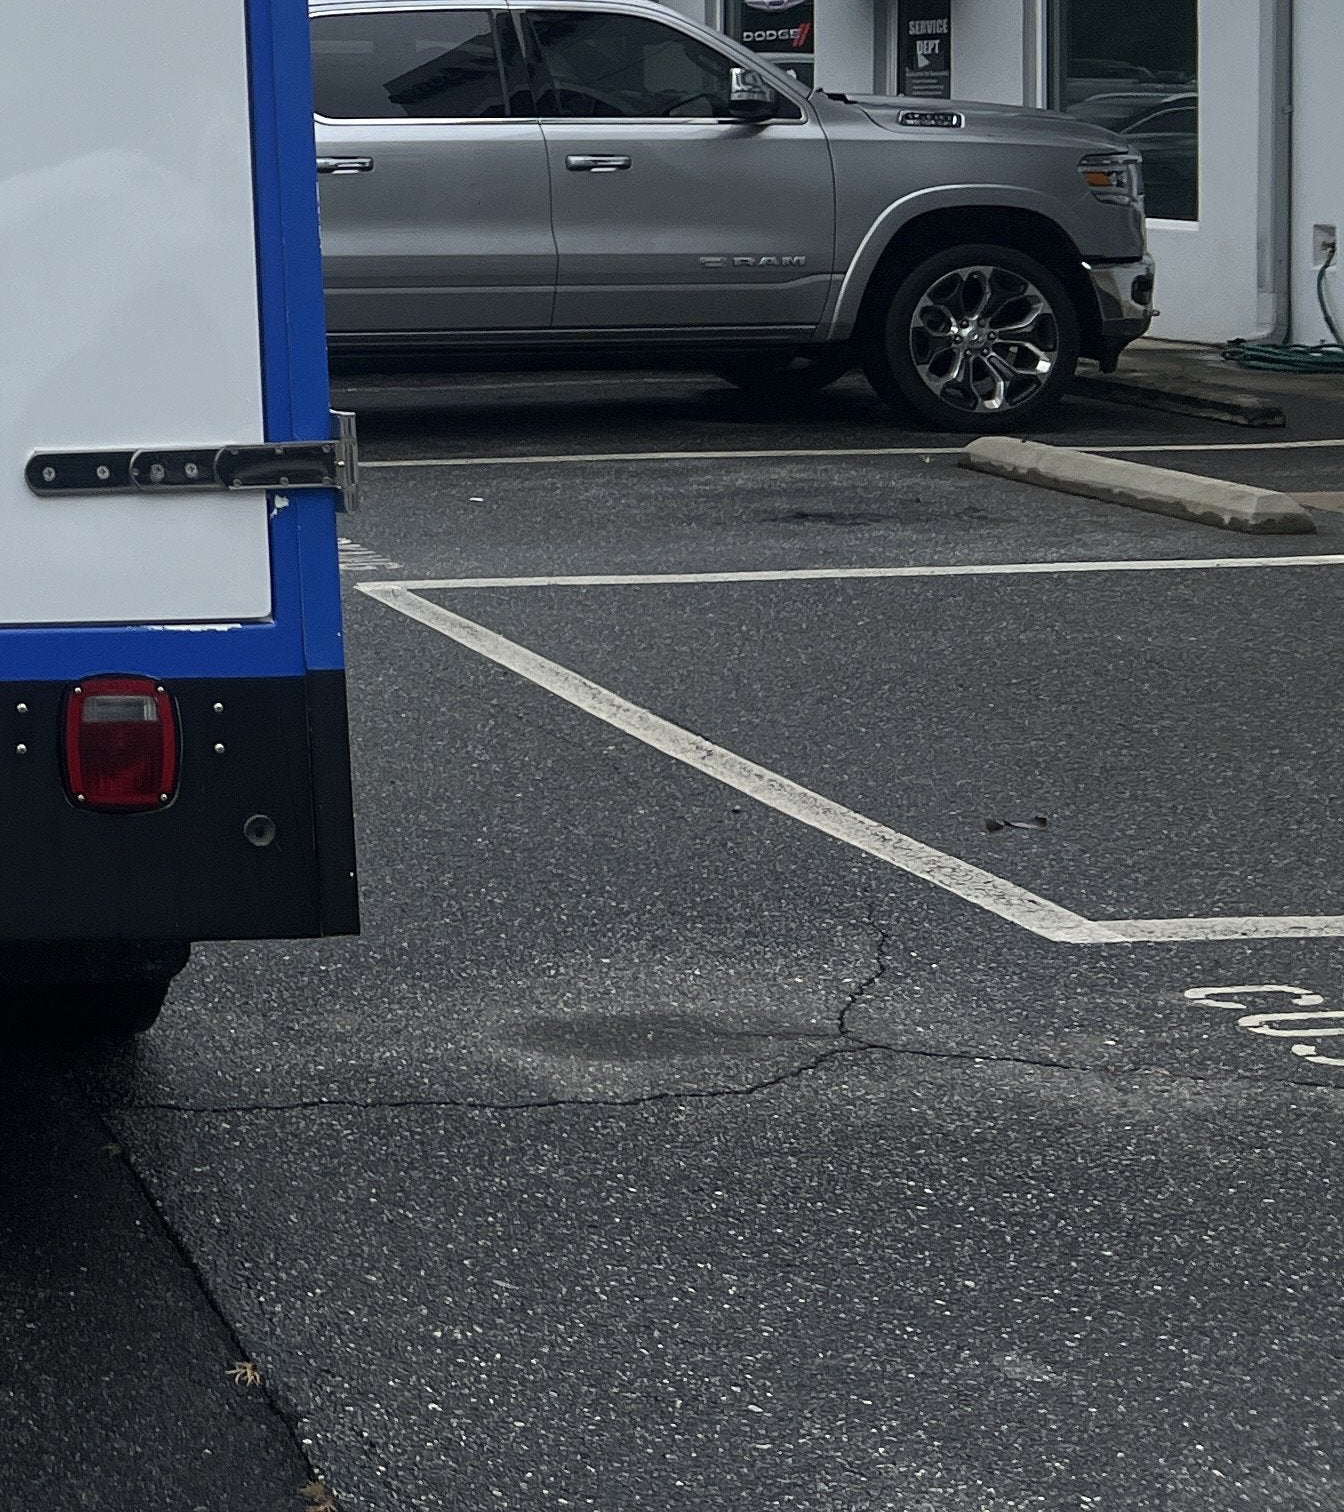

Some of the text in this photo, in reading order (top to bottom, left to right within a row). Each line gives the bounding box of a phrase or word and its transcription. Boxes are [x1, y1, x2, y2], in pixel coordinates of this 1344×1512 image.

[908, 18, 949, 35] SERVICE
[742, 29, 800, 41] DODGE
[916, 39, 940, 55] DEPT
[732, 256, 806, 267] RAM
